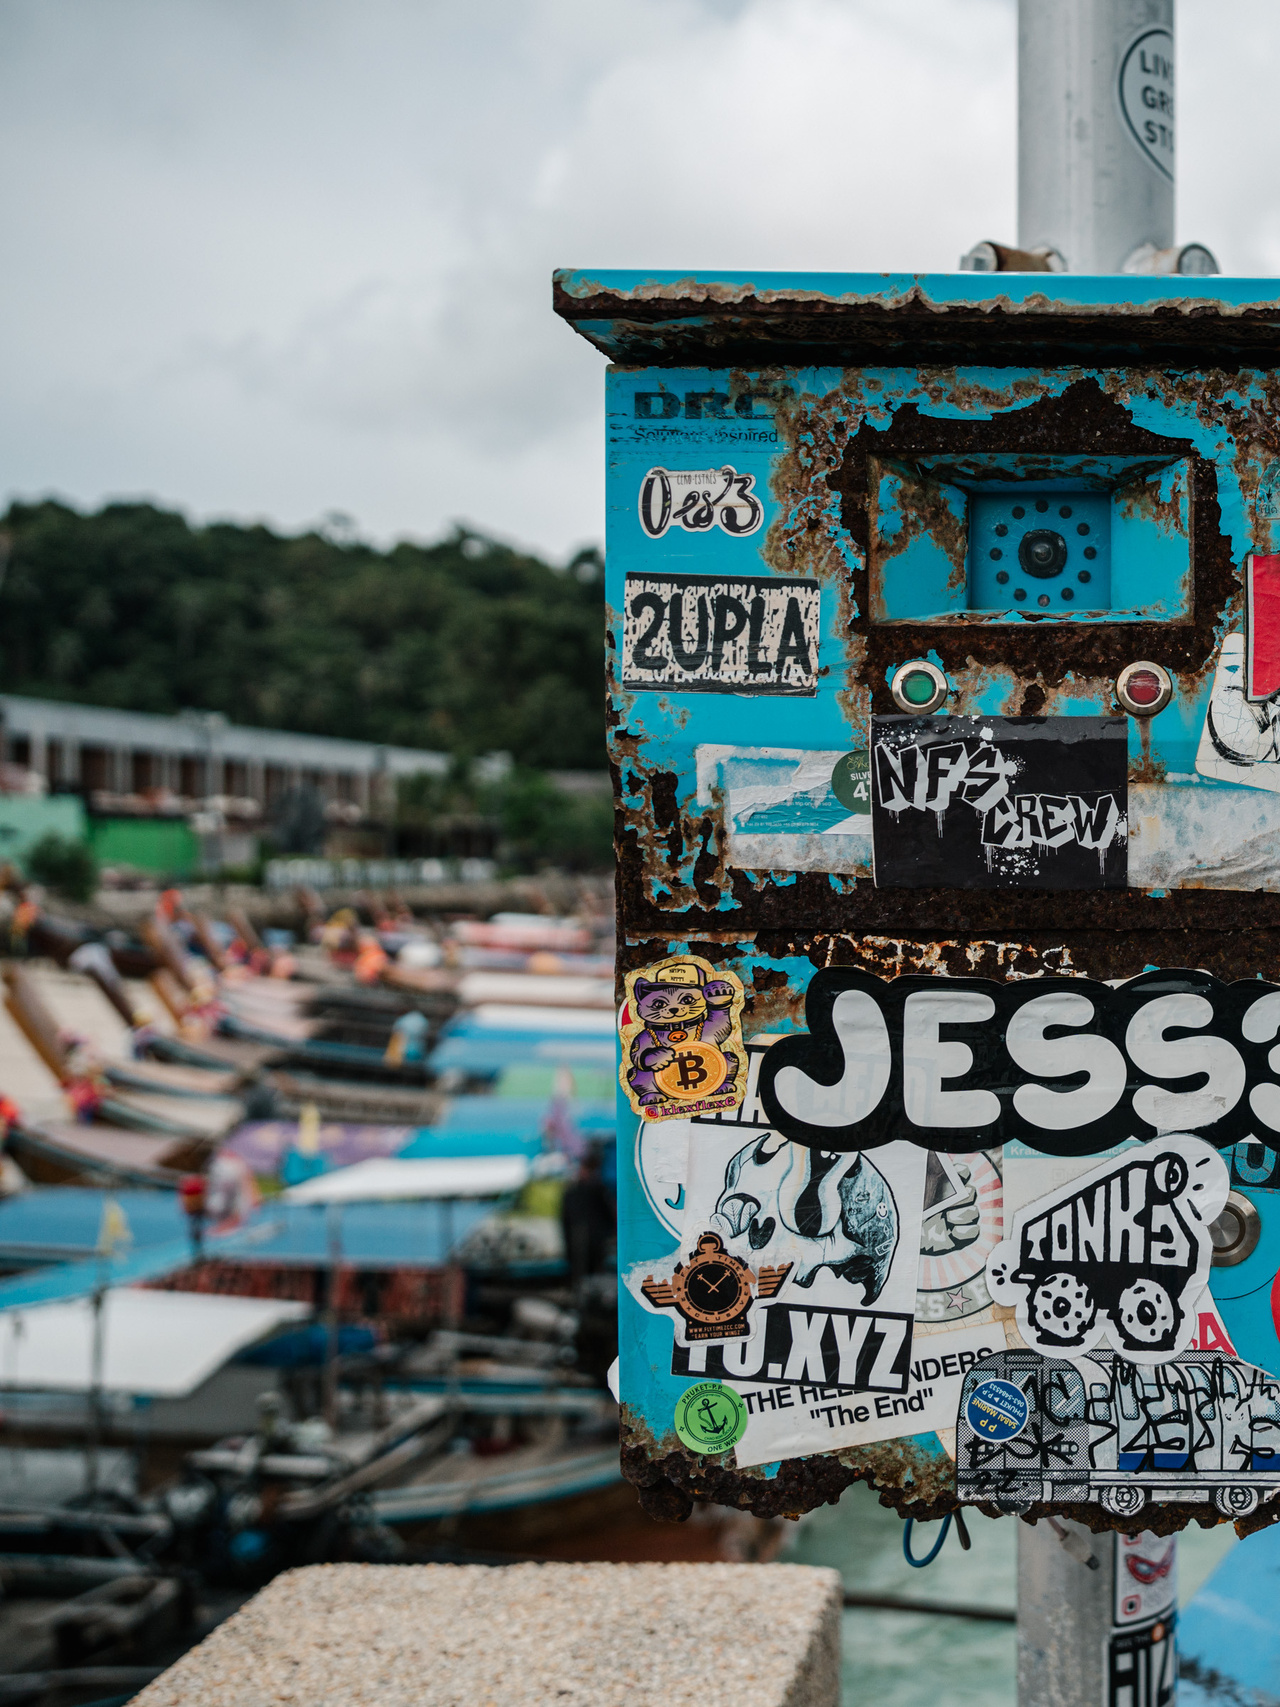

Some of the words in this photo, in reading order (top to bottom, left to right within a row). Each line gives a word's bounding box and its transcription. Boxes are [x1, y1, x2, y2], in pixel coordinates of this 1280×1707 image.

[1141, 85, 1174, 118] GR
[630, 592, 813, 676] 2UPLA
[849, 771, 871, 781] SILVE
[875, 742, 1009, 812] NFS
[981, 794, 1119, 849] CREW
[741, 1386, 795, 1415] THE
[971, 1398, 998, 1418] MARINE
[1000, 1400, 1024, 1417] PHUKET
[997, 1414, 1018, 1430] SABAI
[707, 1443, 724, 1453] ONE
[723, 1435, 738, 1447] WAY
